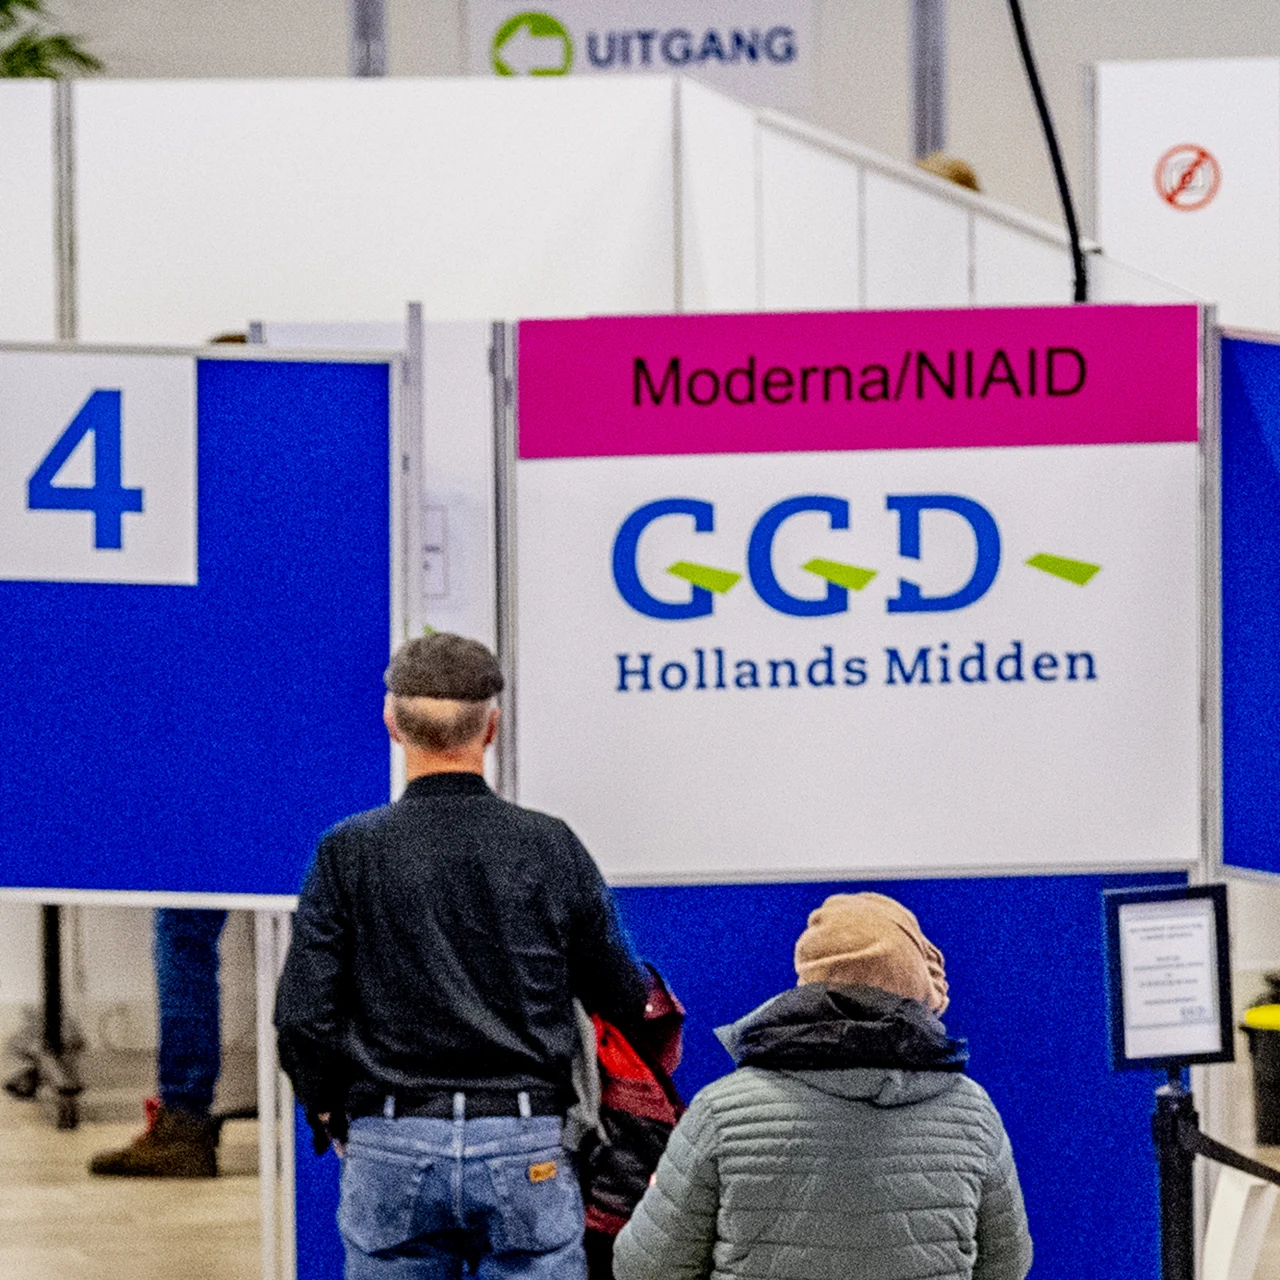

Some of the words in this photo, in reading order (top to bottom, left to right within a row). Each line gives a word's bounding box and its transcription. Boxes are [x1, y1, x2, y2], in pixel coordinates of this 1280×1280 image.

[585, 26, 799, 71] UITGANG
[632, 347, 1087, 407] Moderna/NIAID
[27, 389, 144, 552] 4
[611, 493, 1003, 621] GGD
[617, 646, 869, 694] Hollands
[884, 640, 1099, 688] Midden
